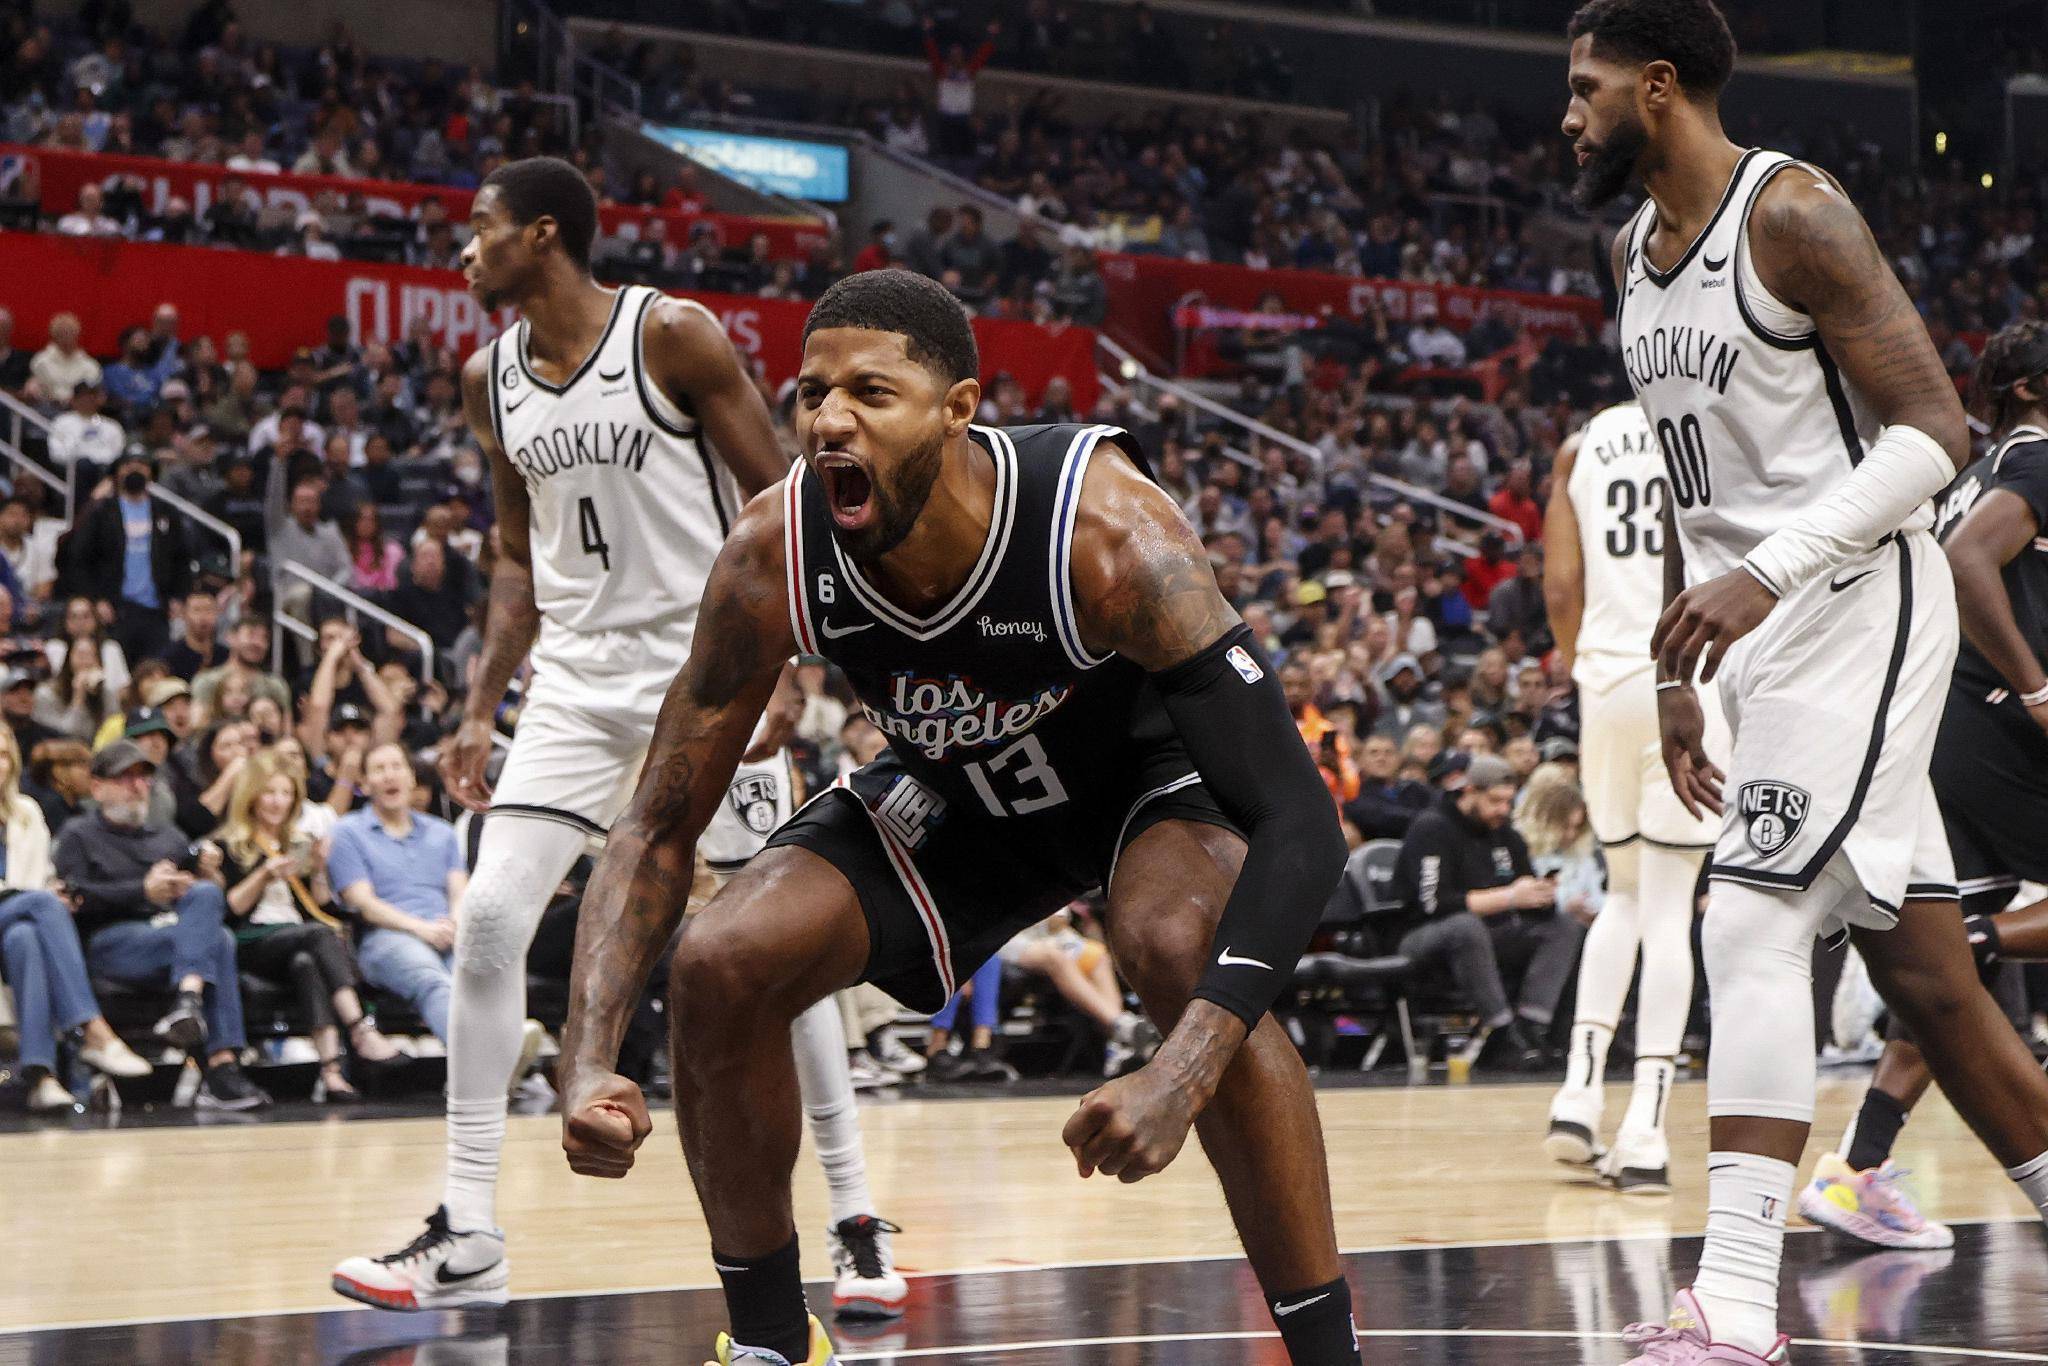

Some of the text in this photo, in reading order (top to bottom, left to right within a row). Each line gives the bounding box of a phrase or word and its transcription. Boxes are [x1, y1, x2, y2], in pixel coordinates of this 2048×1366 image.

[1625, 326, 1740, 395] ROOKLYN
[516, 422, 654, 487] ROOKLYN
[1594, 430, 1659, 467] CLAX
[1657, 413, 1711, 509] 00
[577, 496, 609, 571] 4
[1606, 476, 1665, 557] 33
[817, 572, 836, 604] 6
[976, 614, 1048, 642] honey
[861, 688, 1069, 760] angeles
[891, 675, 985, 716] los
[962, 732, 1069, 817] 13
[1741, 784, 1805, 821] NETS
